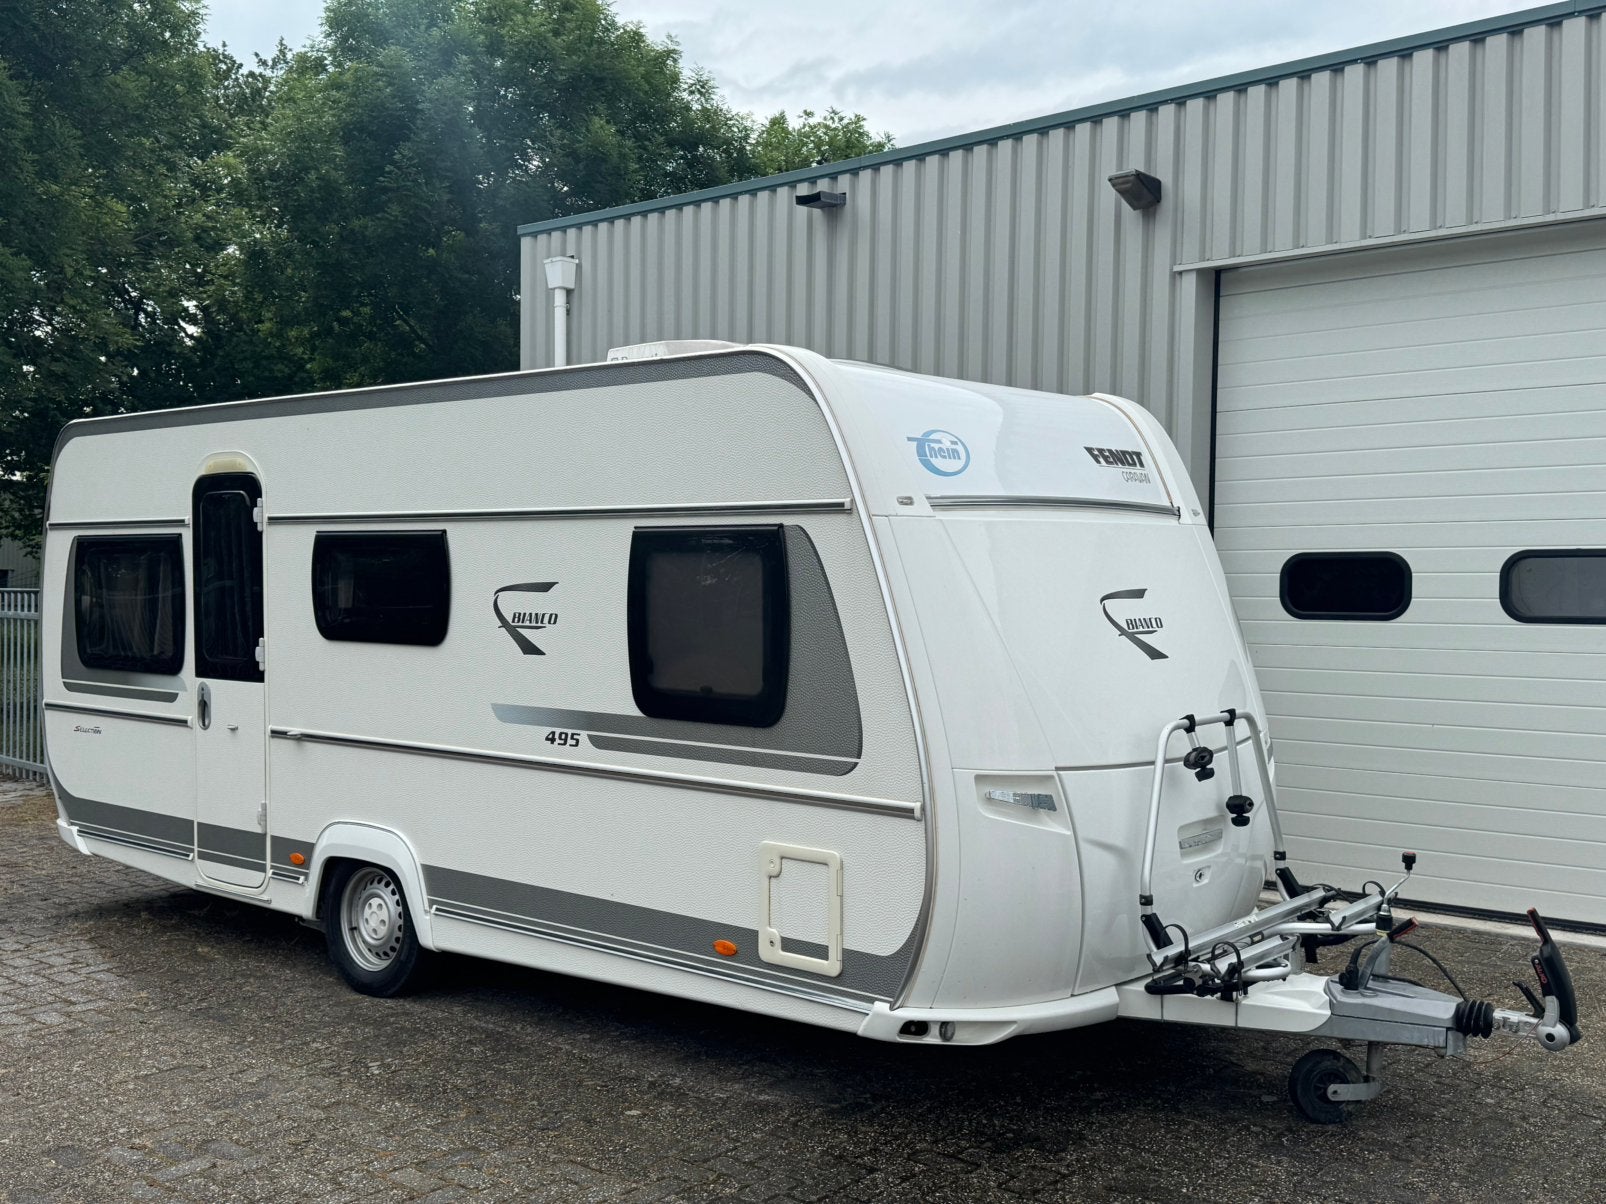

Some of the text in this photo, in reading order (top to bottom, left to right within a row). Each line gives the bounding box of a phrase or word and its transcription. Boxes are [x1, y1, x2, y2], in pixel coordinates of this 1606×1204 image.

[906, 431, 966, 473] Thein
[1083, 446, 1146, 468] FENDT
[511, 611, 559, 625] BIANCO
[1125, 617, 1164, 631] BIANCO
[544, 730, 581, 747] 495
